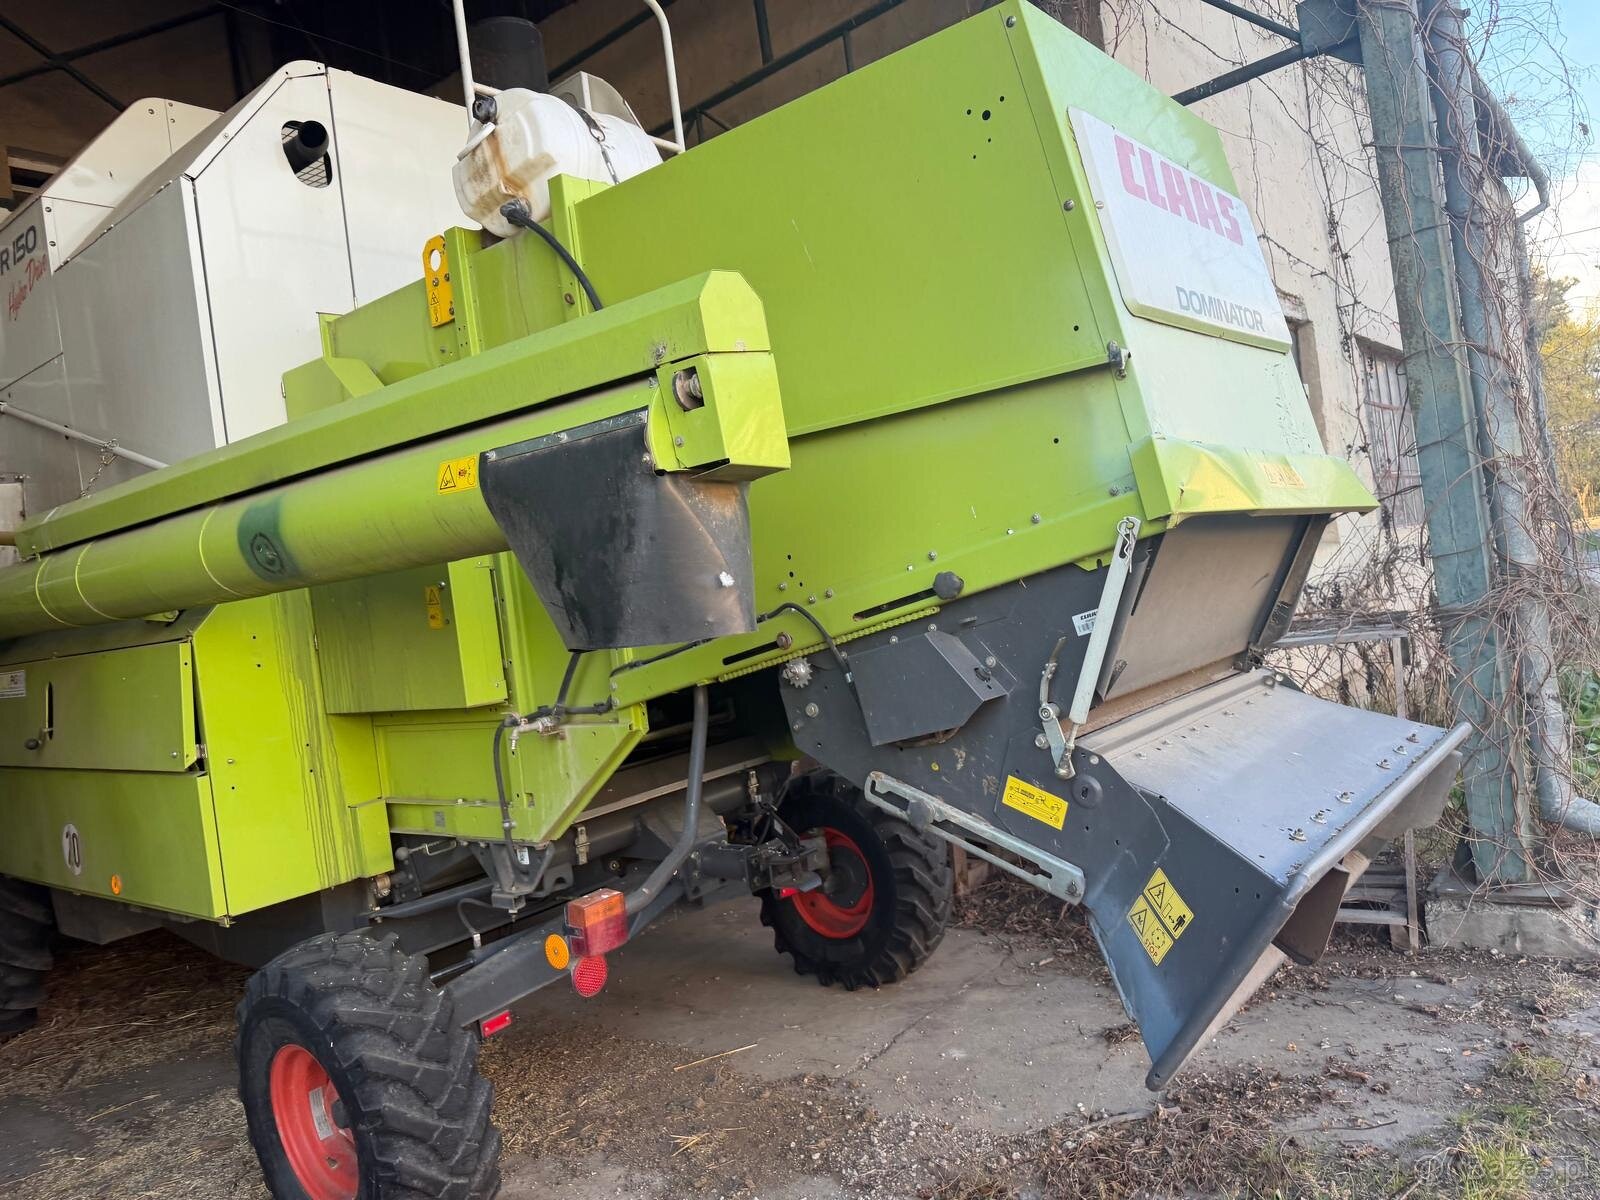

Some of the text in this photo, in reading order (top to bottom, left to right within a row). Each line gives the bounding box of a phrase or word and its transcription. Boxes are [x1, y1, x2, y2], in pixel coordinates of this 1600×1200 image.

[1114, 134, 1244, 247] CLAAS
[13, 225, 37, 266] 150
[1176, 286, 1266, 333] DOMINATOR
[1145, 939, 1158, 957] STOP
